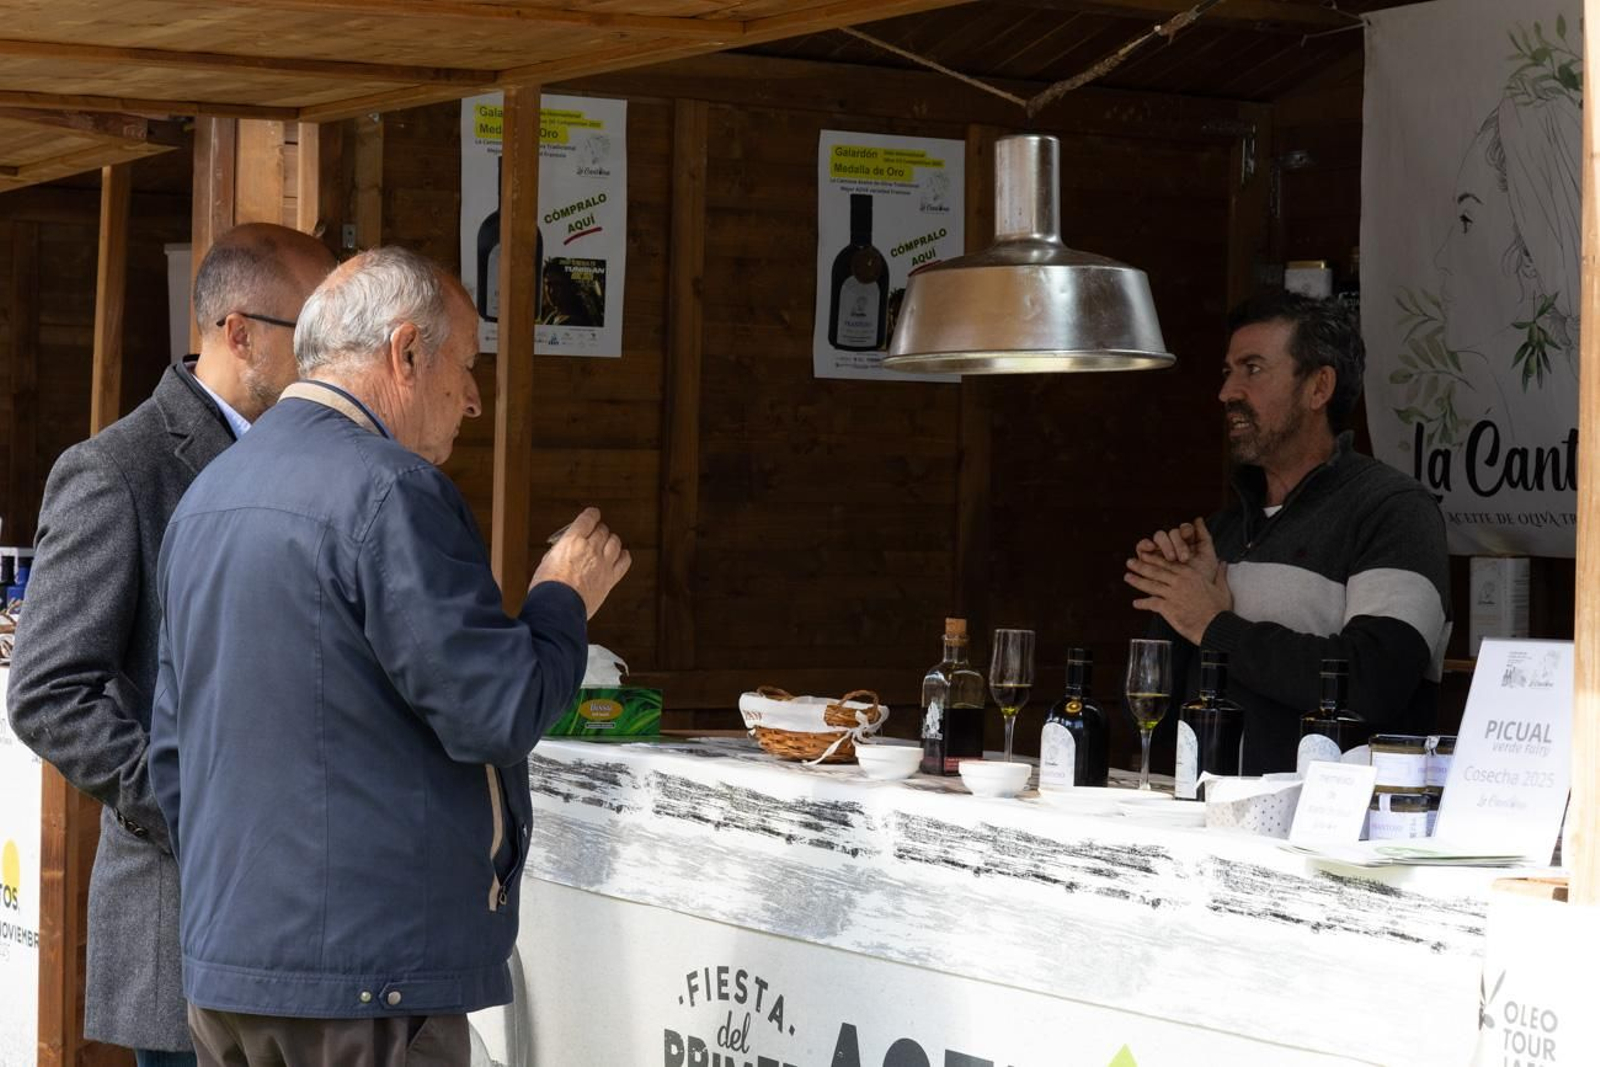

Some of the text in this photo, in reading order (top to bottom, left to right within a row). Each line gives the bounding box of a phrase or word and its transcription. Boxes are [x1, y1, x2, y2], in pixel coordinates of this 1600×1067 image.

[834, 147, 878, 159] Galardón
[834, 162, 905, 178] Medalla de Oro
[543, 193, 609, 225] CÓMPRALO
[567, 213, 597, 233] AQUÍ
[890, 228, 948, 258] CÓMPRALO
[911, 247, 937, 266] AQUÍ
[1497, 512, 1516, 525] DE
[1518, 511, 1560, 529] OLIVA
[1484, 719, 1553, 744] PICUAL
[1463, 765, 1519, 786] Cosecha
[1521, 770, 1555, 789] 2025
[0, 920, 40, 949] OVIEMBR
[1504, 1000, 1558, 1034] OLEO
[717, 1009, 751, 1054] del
[1503, 1027, 1557, 1063] TOUR
